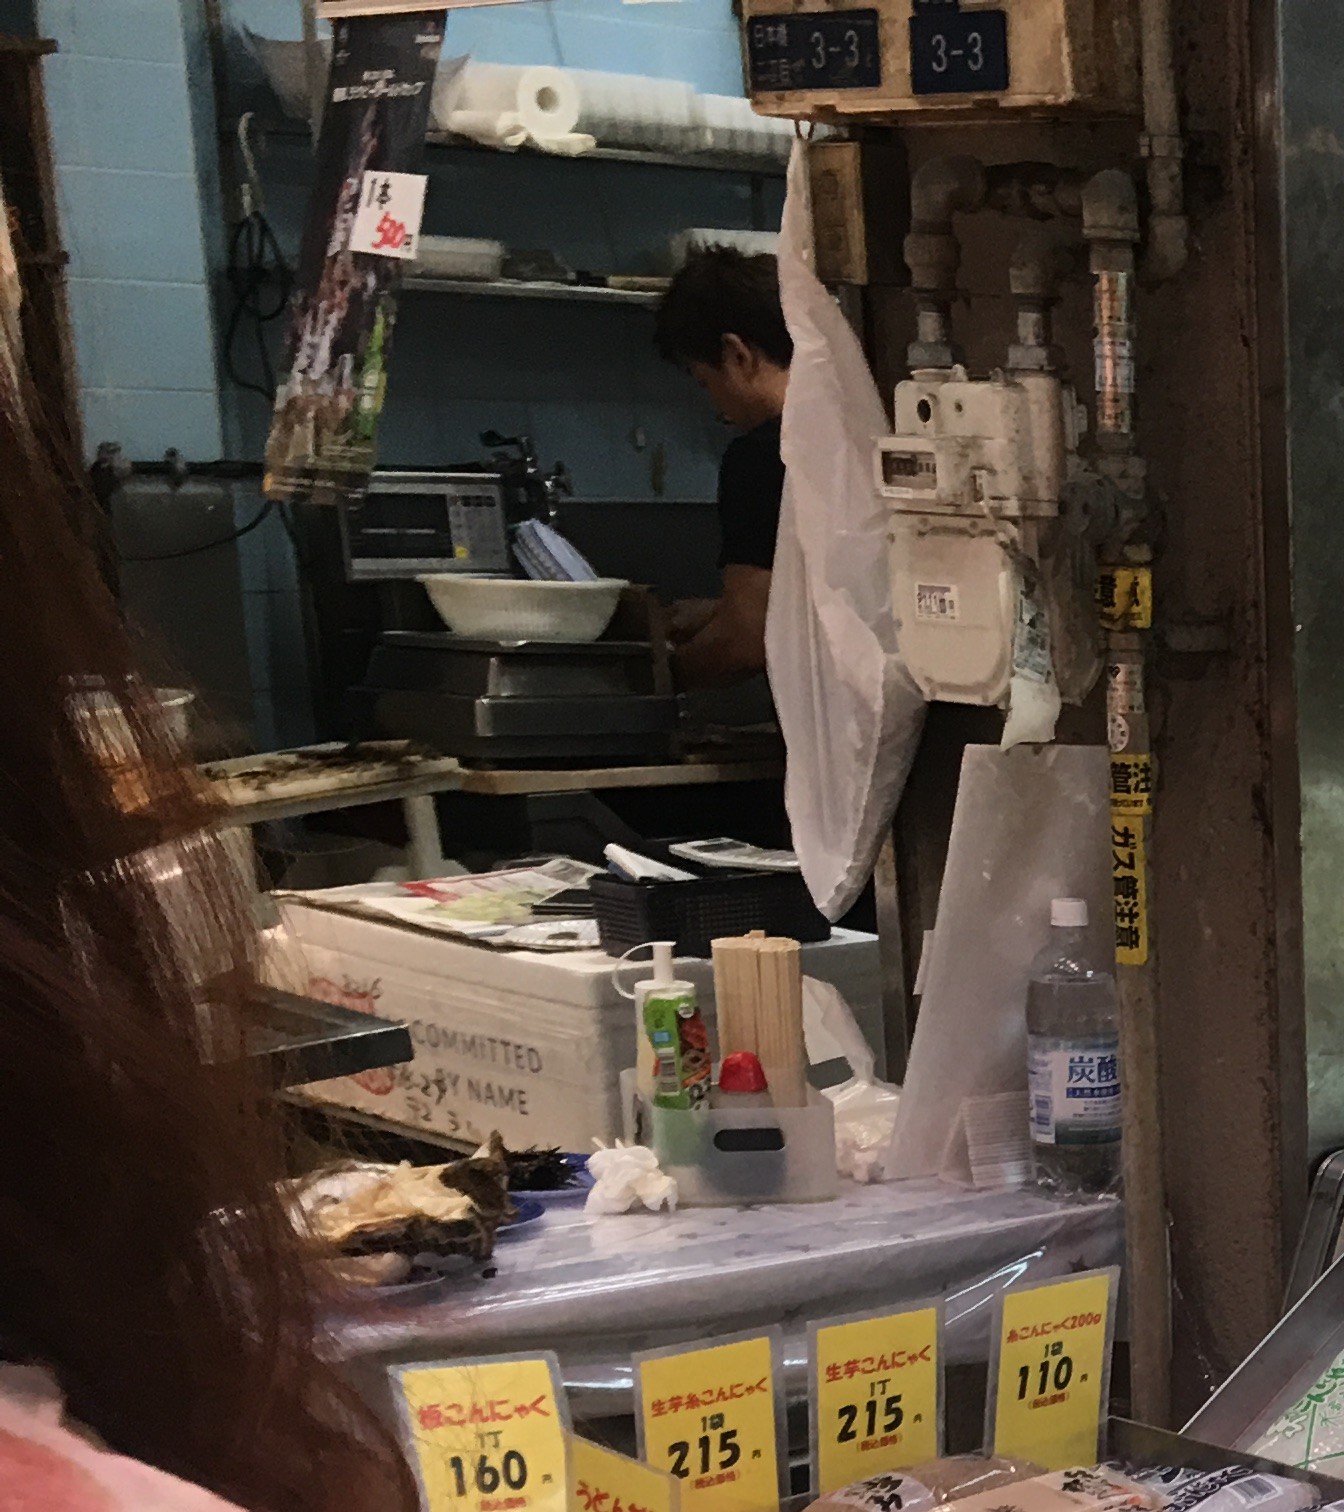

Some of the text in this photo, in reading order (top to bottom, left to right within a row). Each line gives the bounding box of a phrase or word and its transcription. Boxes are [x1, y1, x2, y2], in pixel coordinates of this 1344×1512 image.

[811, 30, 860, 69] 3-3
[931, 33, 985, 72] 3-3
[411, 1019, 544, 1075] COMMITTED
[468, 1077, 529, 1116] NAME
[1017, 1356, 1073, 1400] 110
[837, 1395, 904, 1444] 215
[450, 1450, 528, 1497] 160
[667, 1430, 742, 1480] 215
